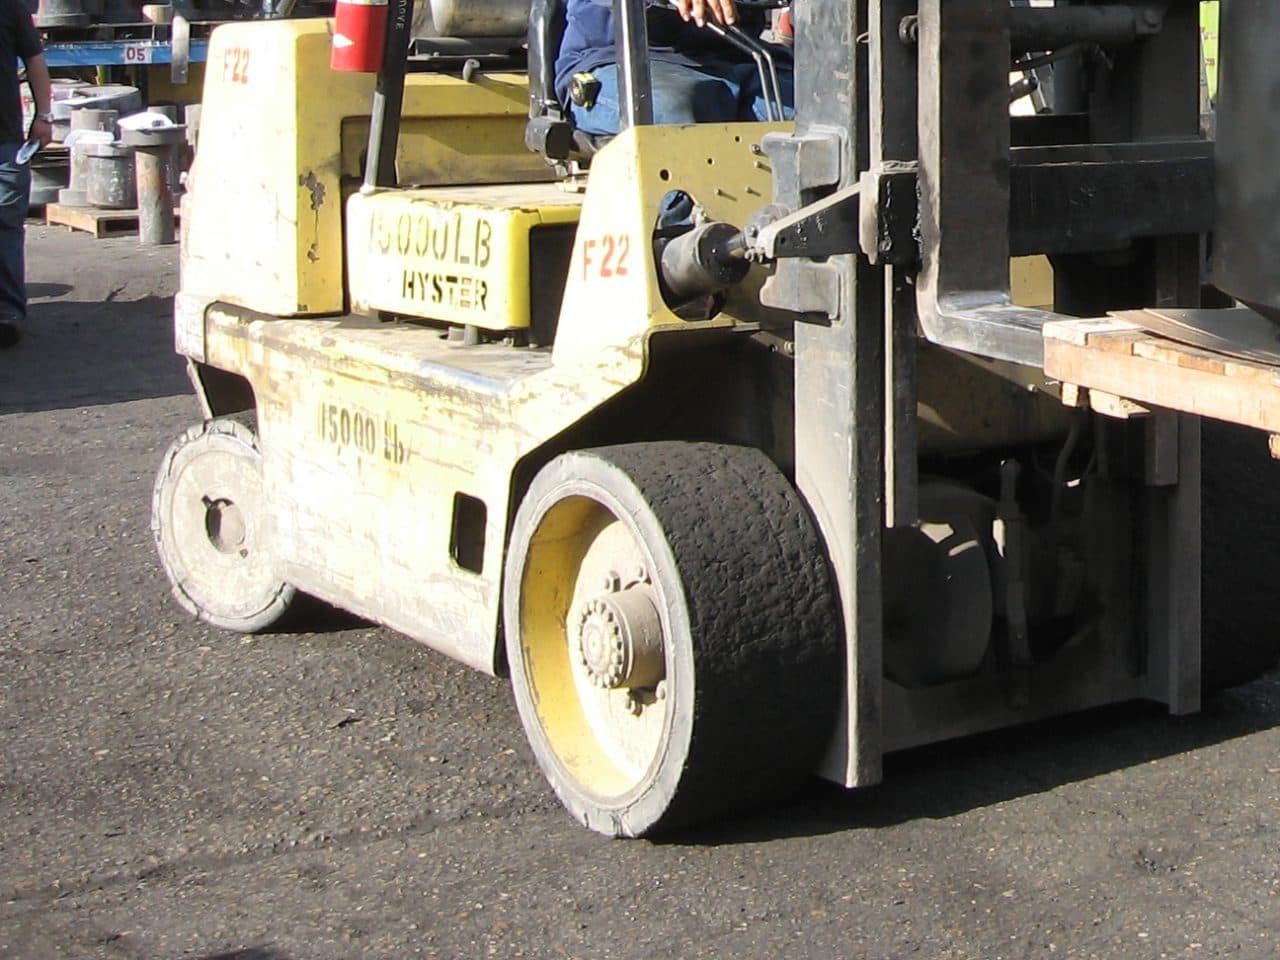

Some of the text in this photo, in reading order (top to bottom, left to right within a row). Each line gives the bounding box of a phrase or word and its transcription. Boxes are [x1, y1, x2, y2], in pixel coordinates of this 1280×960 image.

[126, 47, 146, 61] 05
[224, 47, 251, 84] F22
[583, 233, 630, 281] F22
[402, 270, 488, 311] HYSTER
